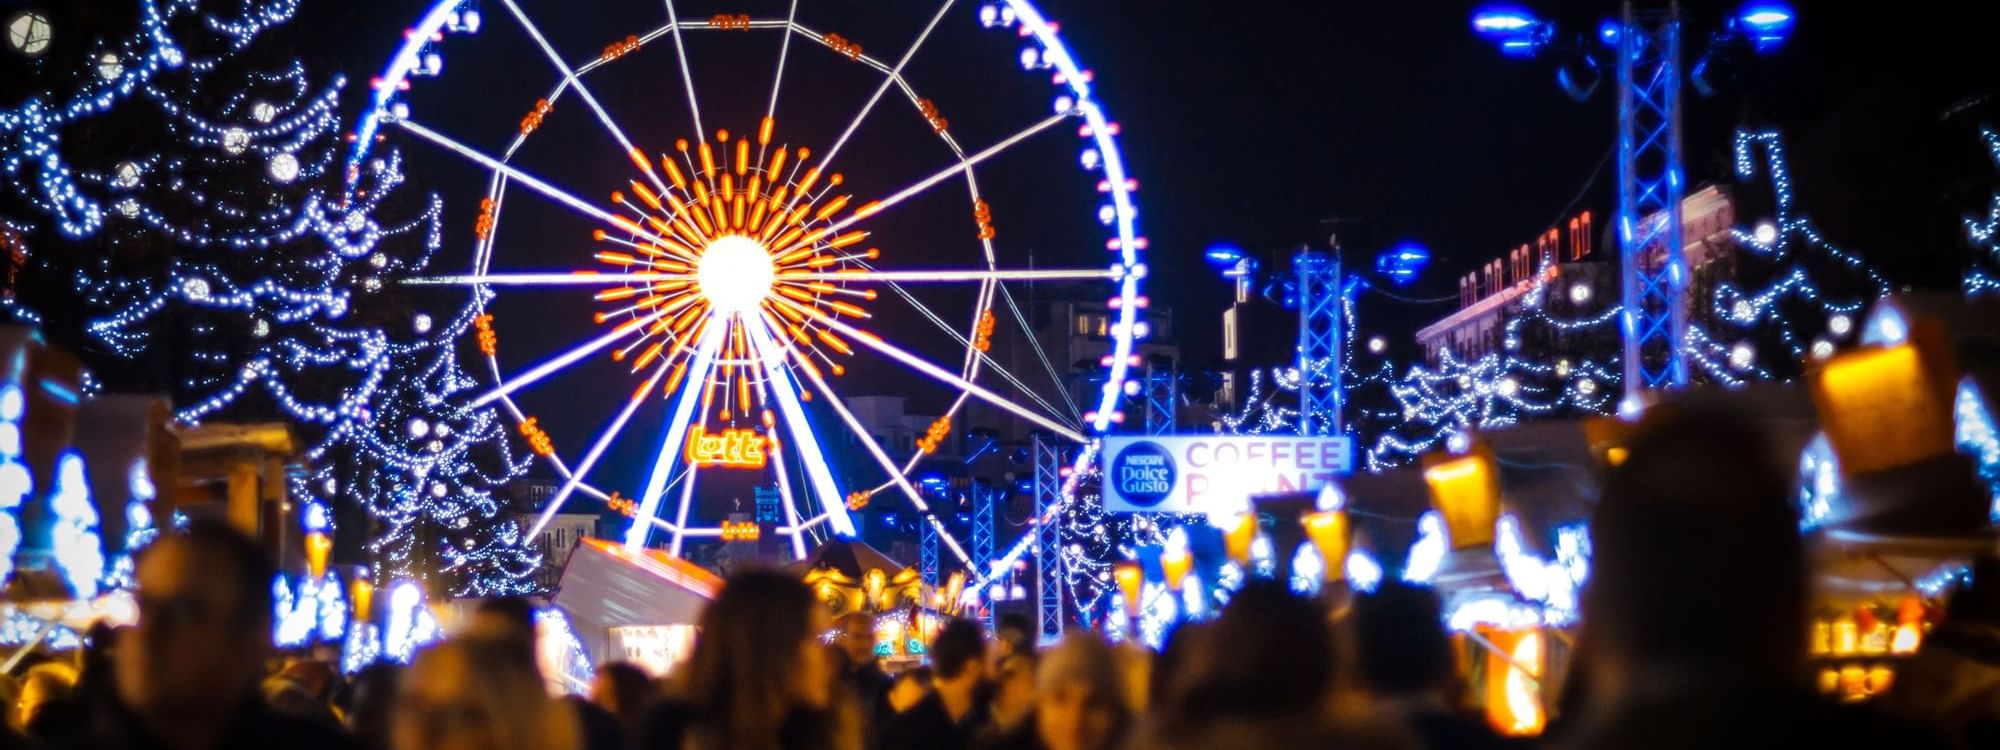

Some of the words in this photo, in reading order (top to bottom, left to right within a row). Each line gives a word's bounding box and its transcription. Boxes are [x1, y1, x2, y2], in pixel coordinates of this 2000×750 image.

[1186, 441, 1341, 468] COFFEE
[1122, 466, 1168, 480] Dolce
[1121, 479, 1169, 493] Gusto
